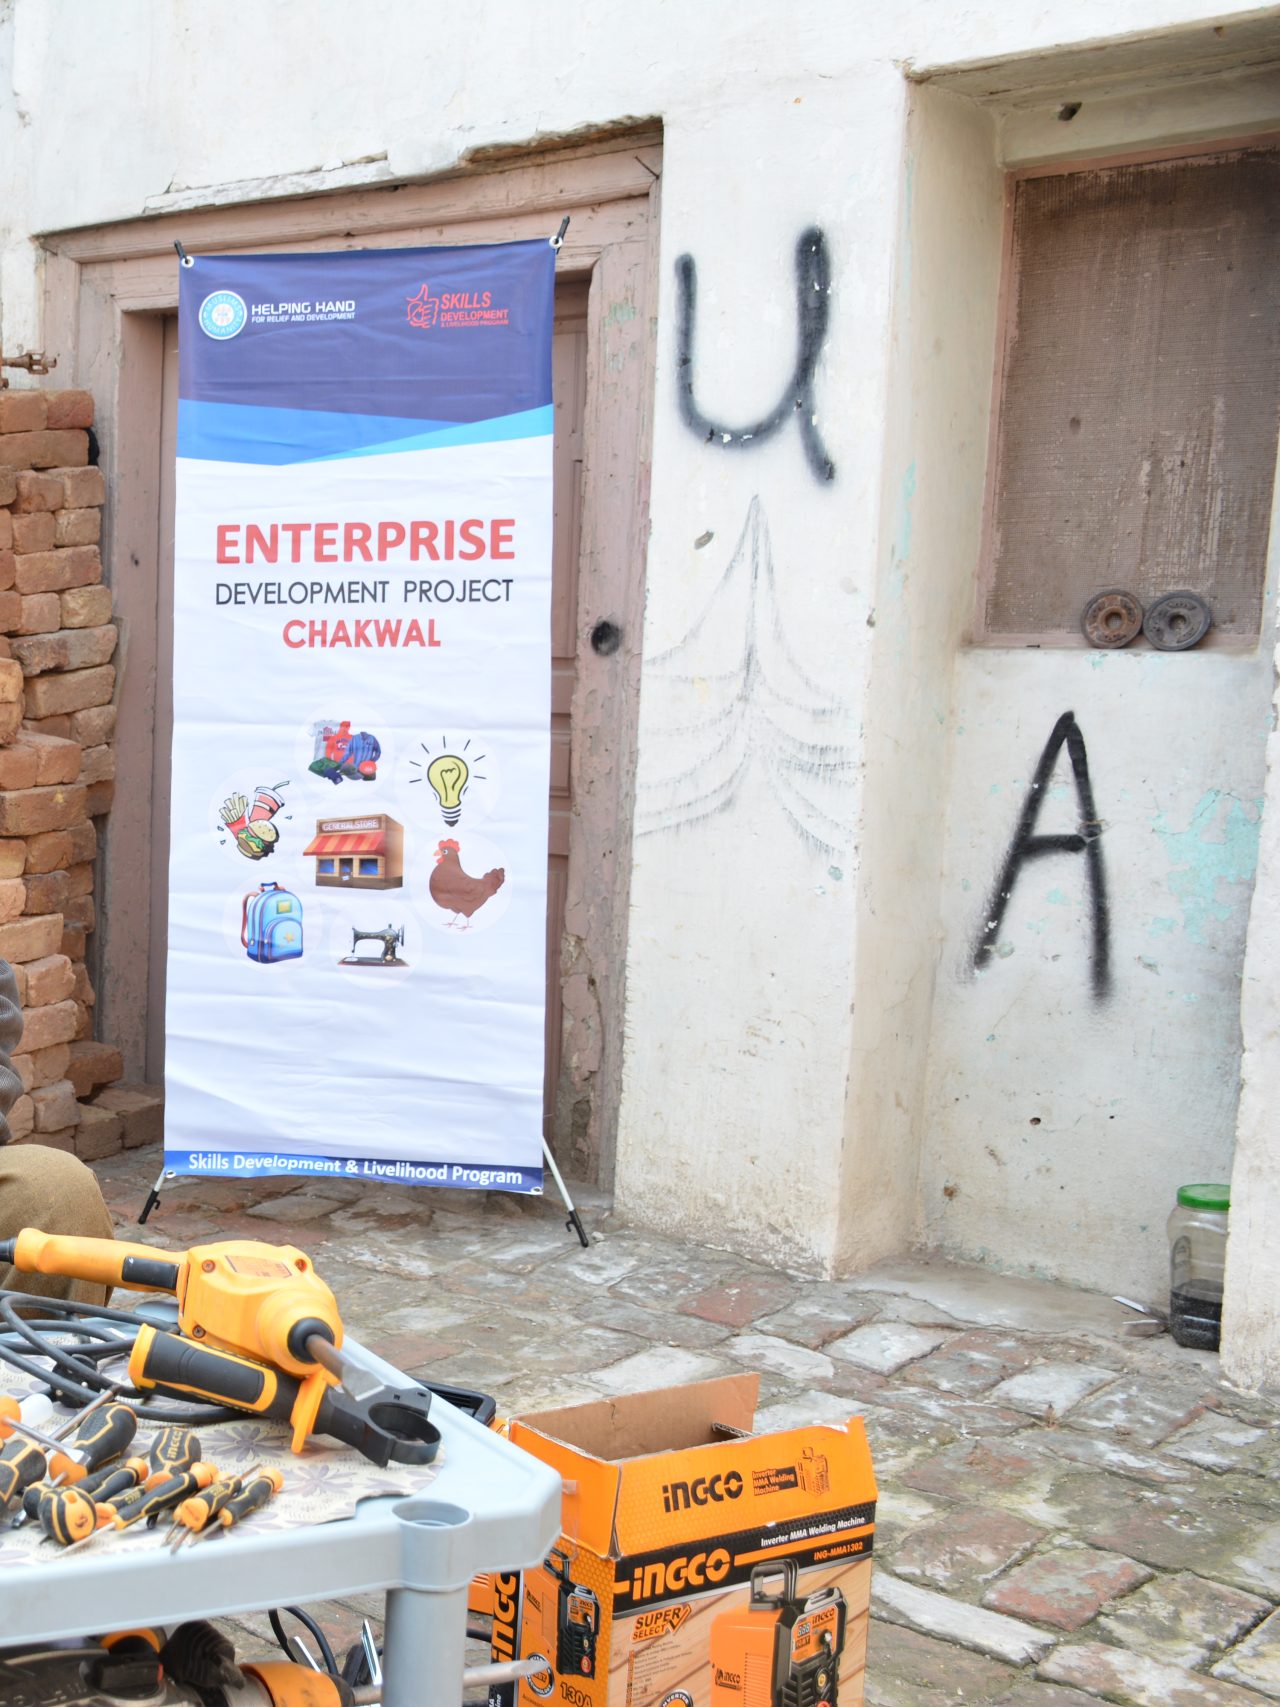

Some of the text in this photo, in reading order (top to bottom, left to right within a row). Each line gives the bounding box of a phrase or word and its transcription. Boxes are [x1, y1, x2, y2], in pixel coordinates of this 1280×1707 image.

[251, 300, 355, 315] HELPING HAND
[441, 292, 491, 309] SKILLS
[267, 315, 288, 323] RELIEF
[291, 314, 305, 322] AND
[307, 312, 355, 321] DEVELOPMENT
[441, 309, 509, 321] DEVELOPMENT
[216, 518, 516, 564] ENTERPRISE
[216, 578, 514, 605] DEVELOPMENT PROJECT
[282, 618, 441, 648] CHAKWAL
[963, 711, 1116, 1000] A
[188, 1153, 523, 1186] Skills Development & Livelihood Program
[760, 1516, 865, 1547] Inverter MMA Welding Machine
[813, 1541, 864, 1561] ING-MMA1302
[635, 1607, 681, 1630] SUPER
[632, 1623, 666, 1640] SELECT
